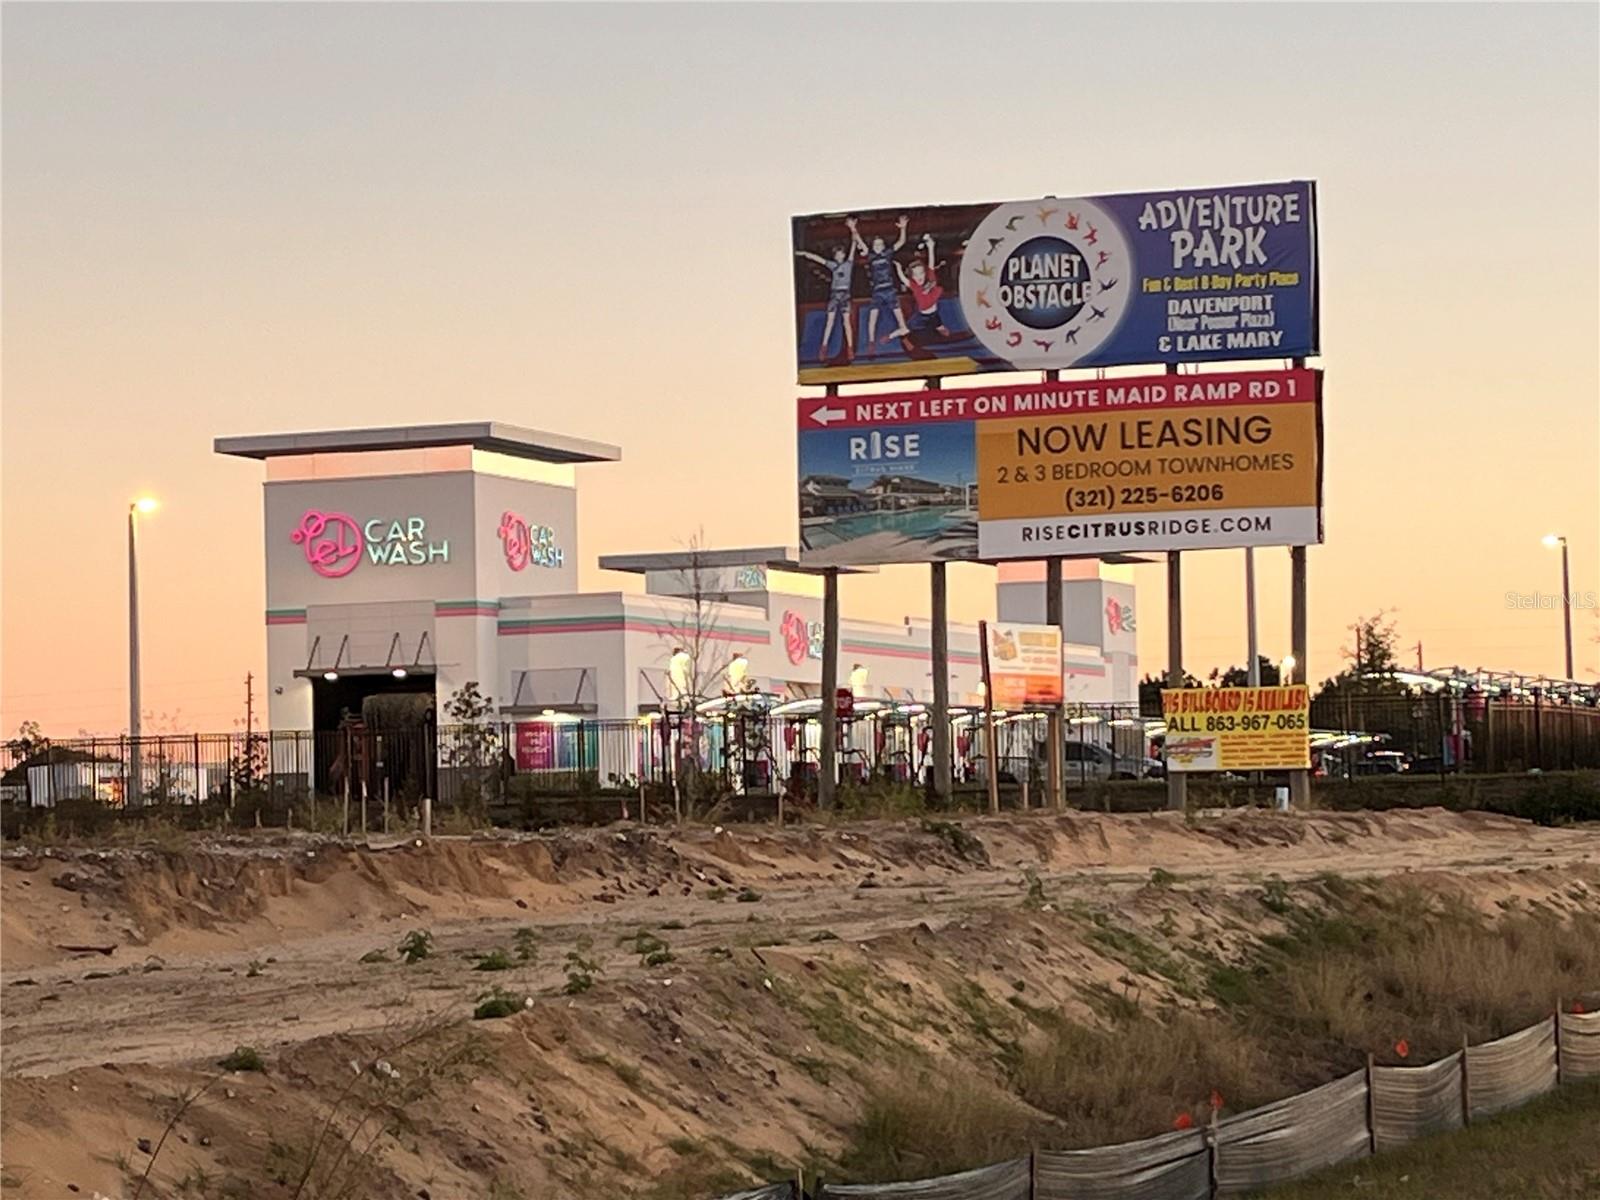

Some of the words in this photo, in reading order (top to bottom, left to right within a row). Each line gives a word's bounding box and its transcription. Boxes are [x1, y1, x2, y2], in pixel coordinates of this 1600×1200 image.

[1138, 194, 1301, 230] ADVENTURE
[1170, 226, 1268, 269] PARK
[1008, 253, 1082, 281] PLANET
[1000, 281, 1092, 310] OBSTACLE
[1167, 295, 1274, 315] DAVENPORT
[1176, 334, 1222, 352] LAKE
[1226, 331, 1283, 349] MARY
[856, 401, 912, 421] NEXT
[920, 398, 967, 417] LEFT
[973, 396, 1008, 414] ON
[1014, 389, 1099, 411] MINUTE
[1106, 385, 1167, 405] MAID
[1174, 382, 1242, 402] RAMP
[1249, 380, 1280, 398] RD
[1287, 379, 1296, 397] 1
[850, 431, 920, 460] RISE
[1018, 423, 1108, 456] NOW
[1120, 415, 1272, 450] LEASING
[997, 466, 1008, 484] 2
[1015, 465, 1029, 483] &
[1035, 464, 1046, 482] 3
[1052, 459, 1151, 481] BEDROOM
[1157, 453, 1294, 477] TOWNHOMES
[1065, 486, 1115, 511] (321)
[1121, 484, 1224, 506] 225-6206
[364, 518, 425, 543] CAR
[530, 525, 555, 545] CAR
[1022, 517, 1272, 542] RISECITRUSRIDGE.COM
[365, 541, 448, 565] WASH
[530, 544, 564, 568] WASH
[1182, 690, 1241, 714] BILLBOARD
[1243, 690, 1254, 712] IS
[1167, 716, 1201, 732] ALL
